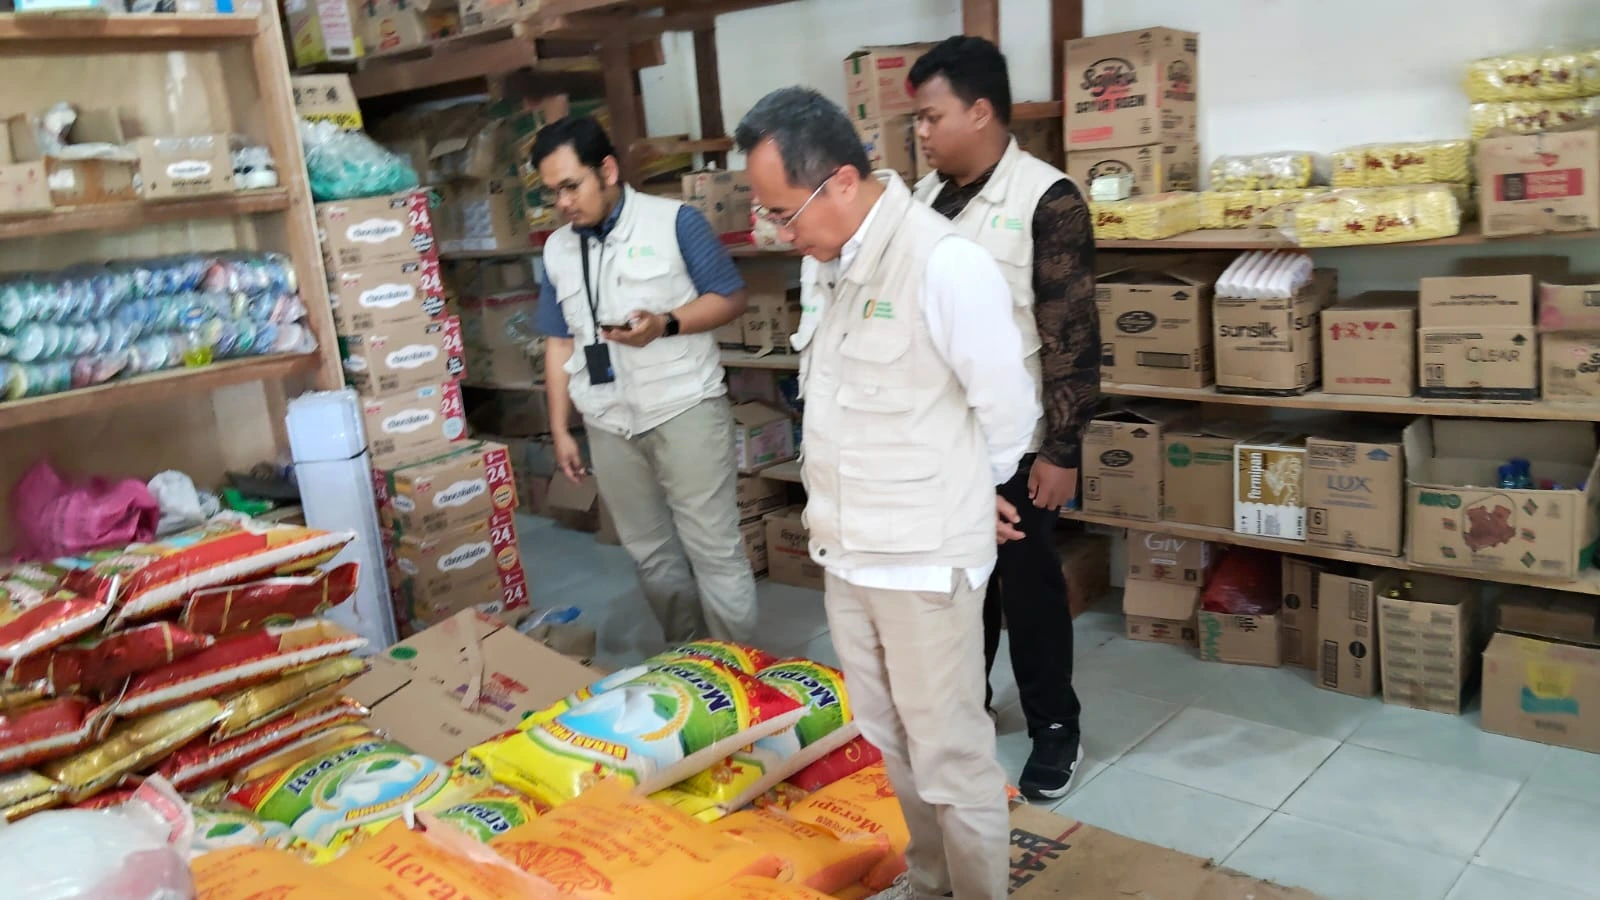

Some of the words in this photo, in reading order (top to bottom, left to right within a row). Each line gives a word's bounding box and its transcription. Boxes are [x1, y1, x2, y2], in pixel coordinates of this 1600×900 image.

[1219, 321, 1278, 338] sunsilk
[1464, 346, 1521, 362] CLEAR
[486, 465, 507, 484] 24
[1327, 474, 1374, 494] LUX
[490, 529, 512, 546] 24
[504, 587, 525, 605] 24
